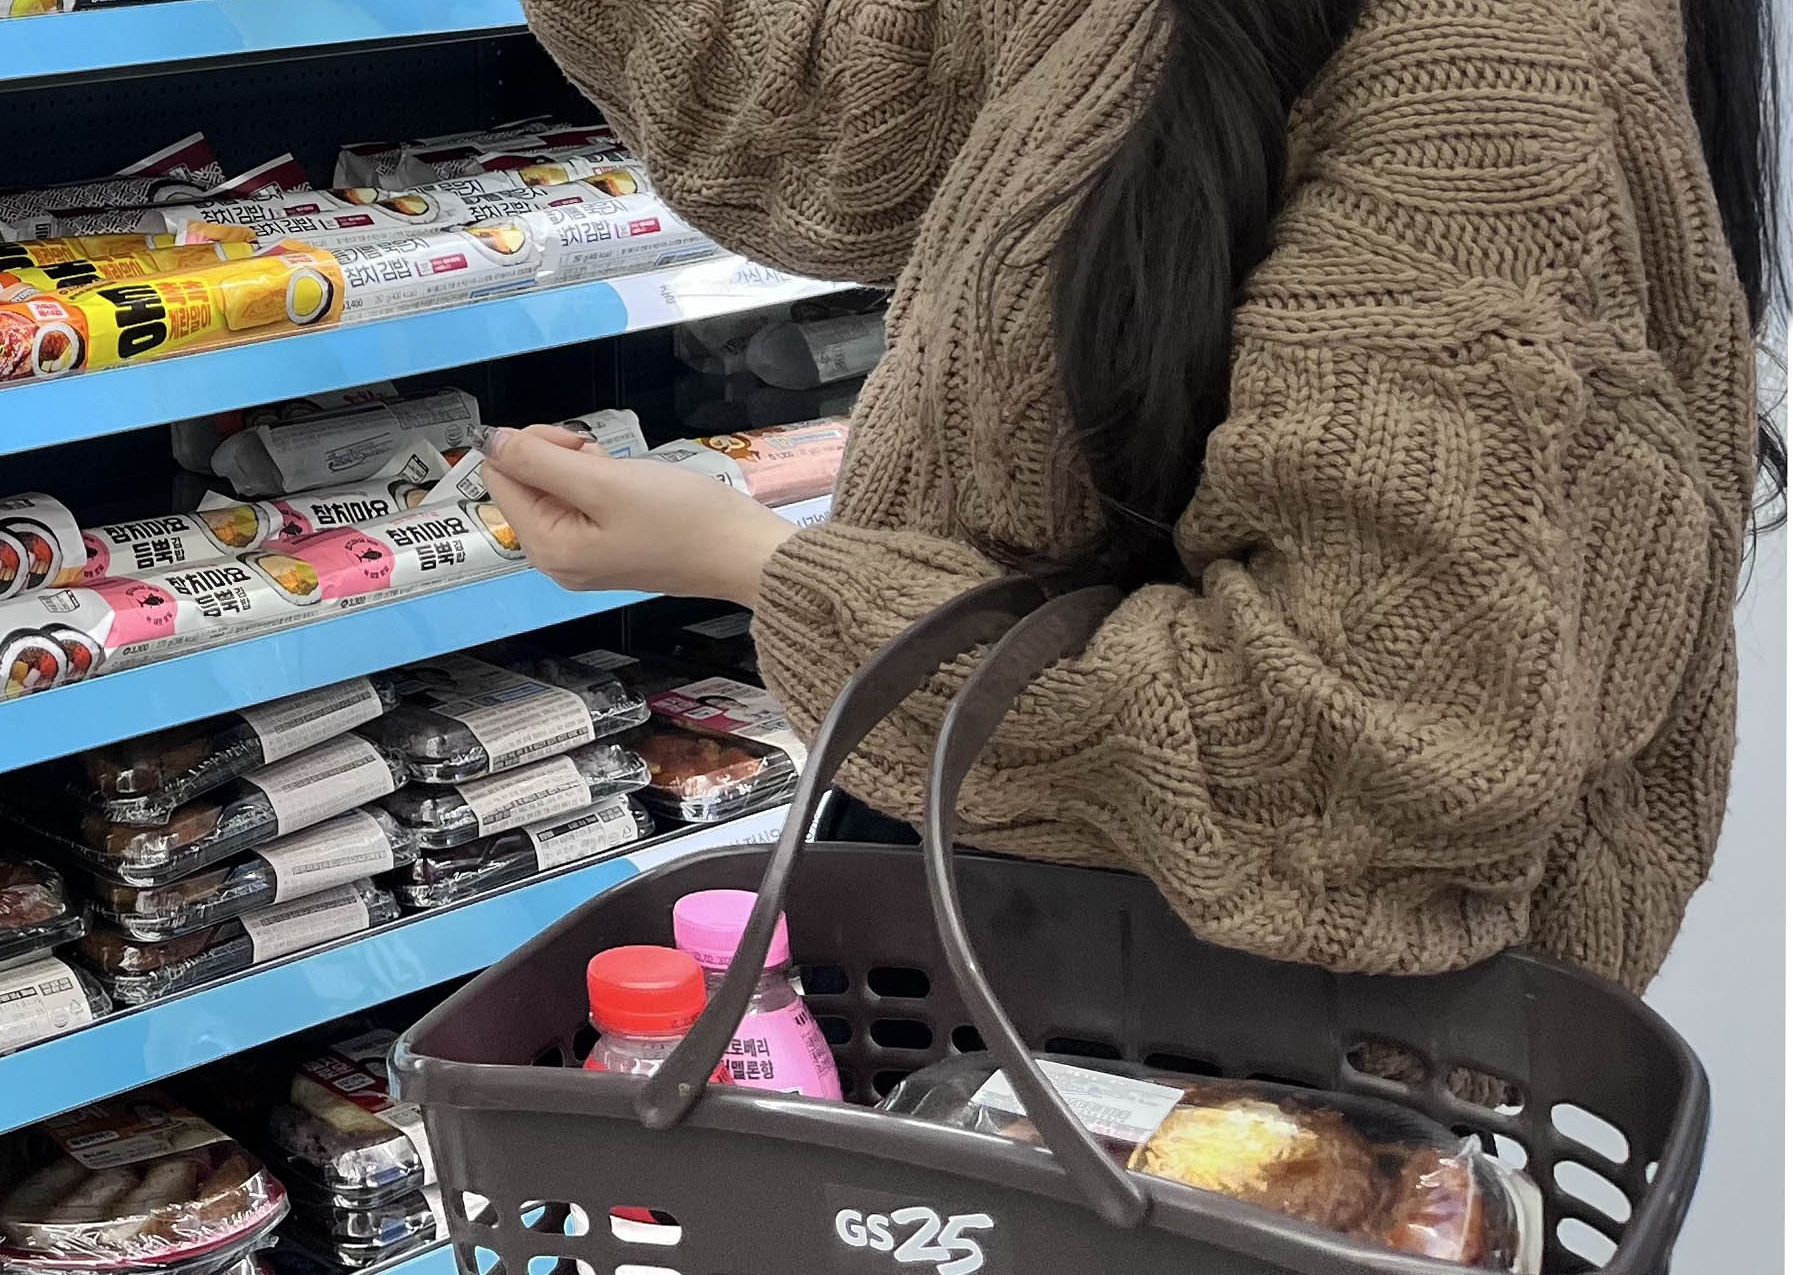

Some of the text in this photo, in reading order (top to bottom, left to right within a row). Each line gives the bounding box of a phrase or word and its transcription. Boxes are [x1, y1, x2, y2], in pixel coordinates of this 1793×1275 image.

[104, 515, 190, 546] 참치마요
[387, 515, 469, 547] 참치마요
[131, 539, 173, 571] 듬뿍
[417, 541, 452, 571] 듬뿍
[722, 1037, 769, 1057] 로베리
[837, 1207, 995, 1275] GS25
